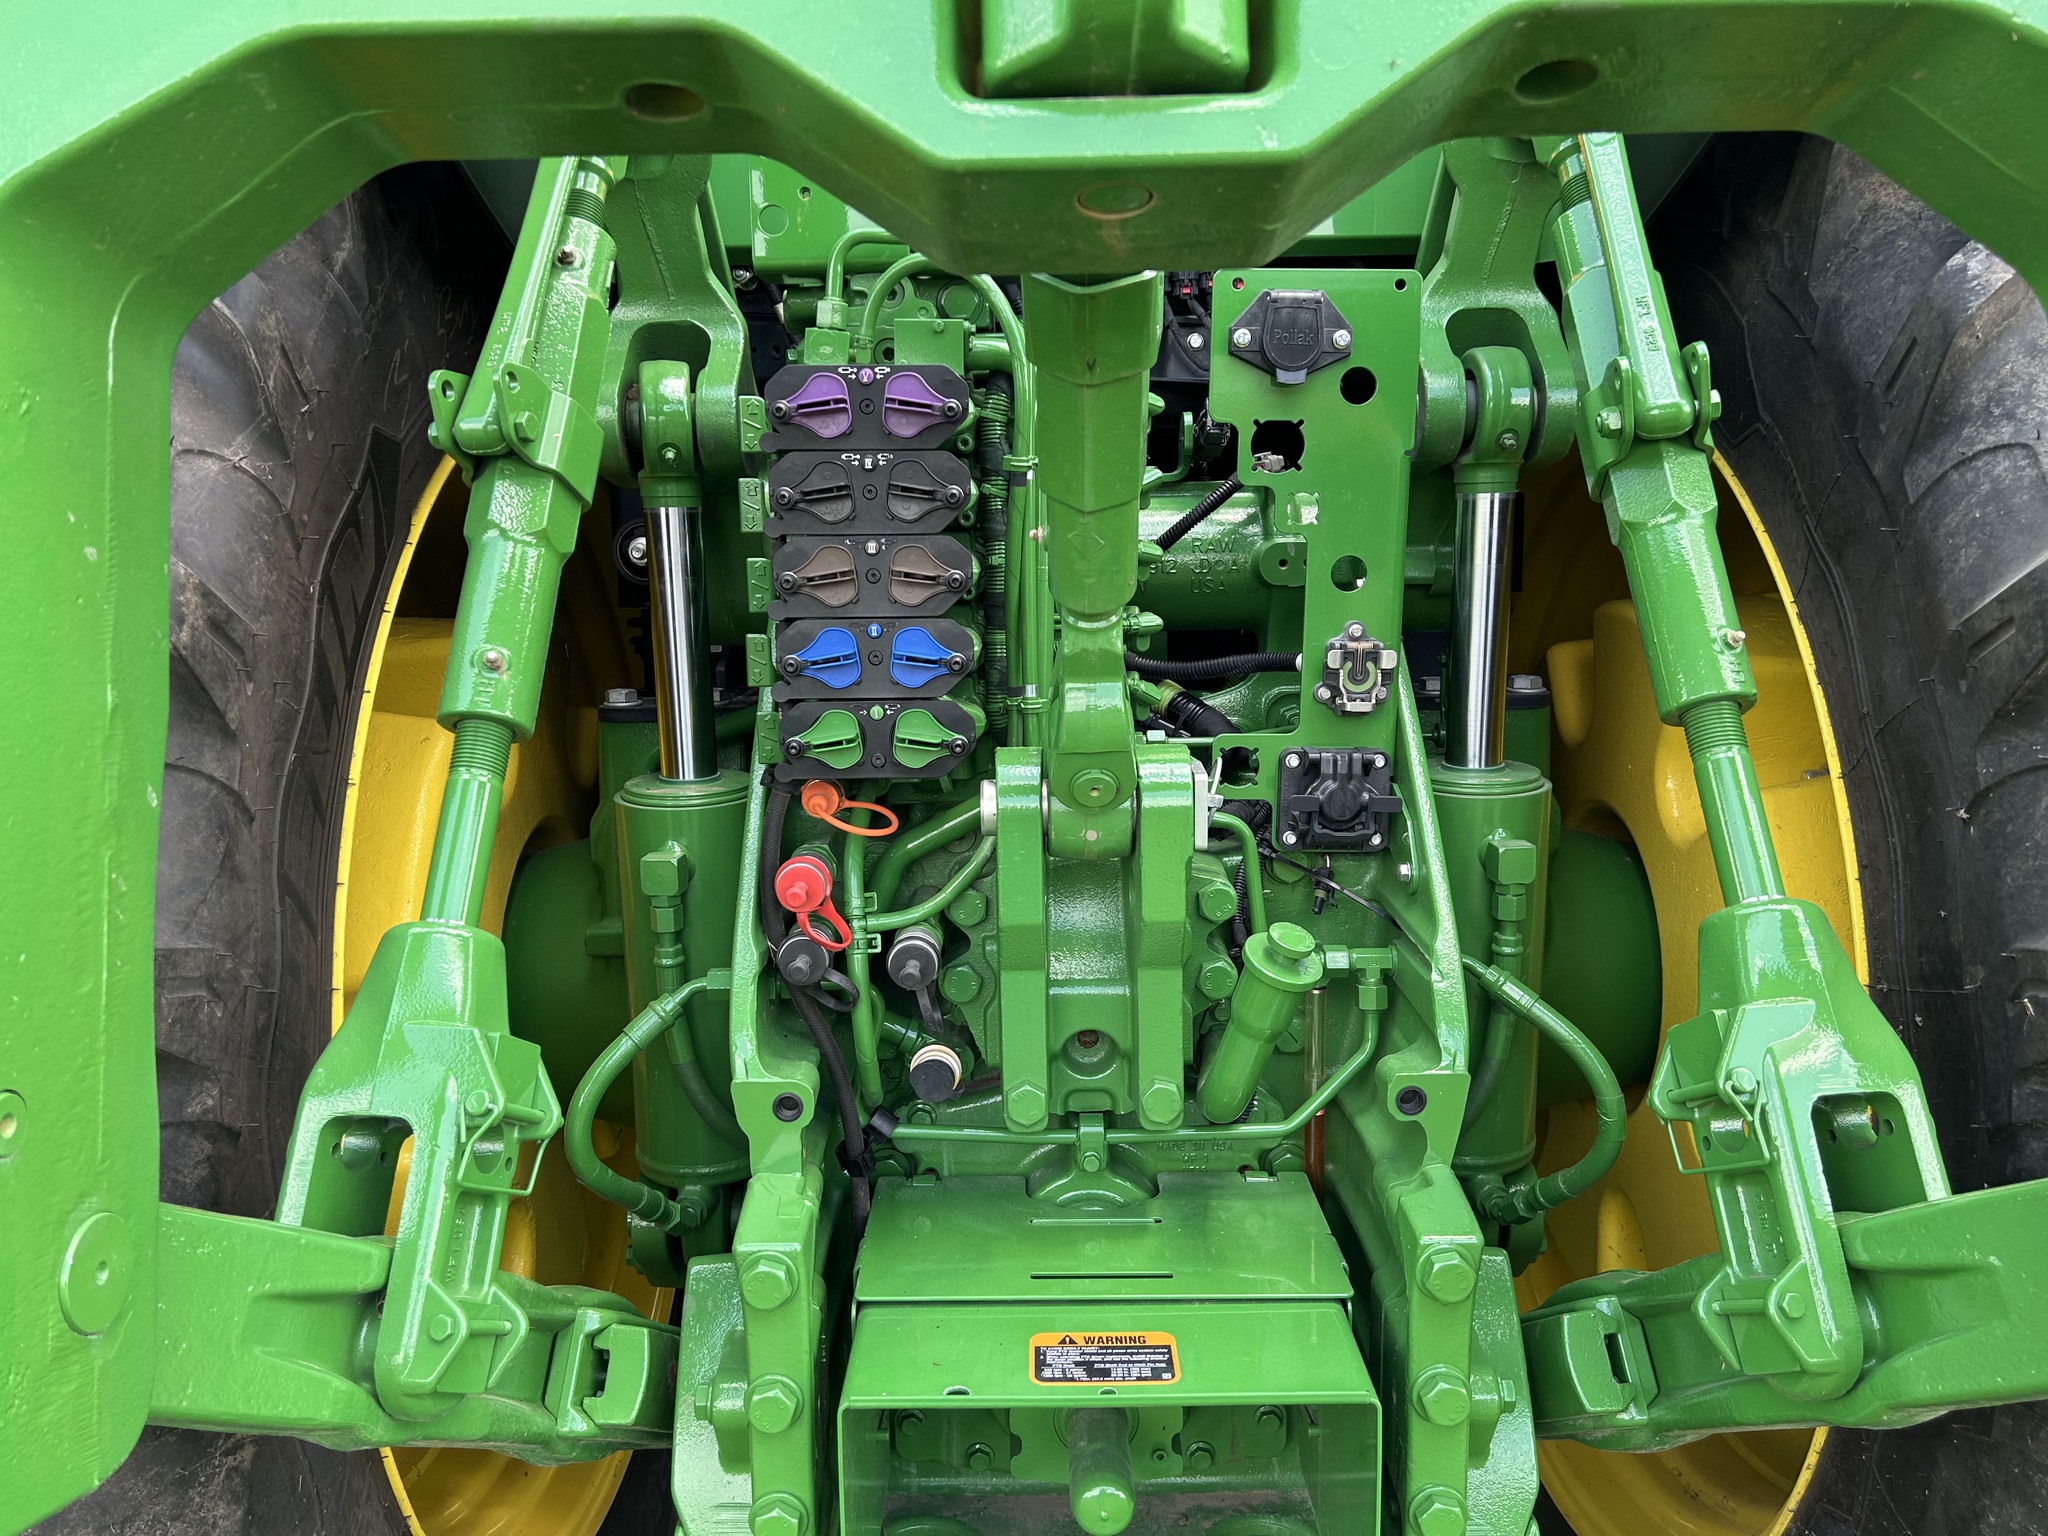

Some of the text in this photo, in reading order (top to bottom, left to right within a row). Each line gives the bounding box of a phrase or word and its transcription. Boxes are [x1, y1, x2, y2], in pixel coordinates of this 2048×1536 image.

[1272, 329, 1314, 346] Pollak
[861, 371, 870, 382] V
[867, 542, 877, 554] III
[1191, 536, 1236, 553] RAW
[1191, 576, 1227, 594] USA
[871, 626, 878, 636] II
[1212, 1140, 1234, 1151] USA
[1083, 1335, 1147, 1345] WARNING
